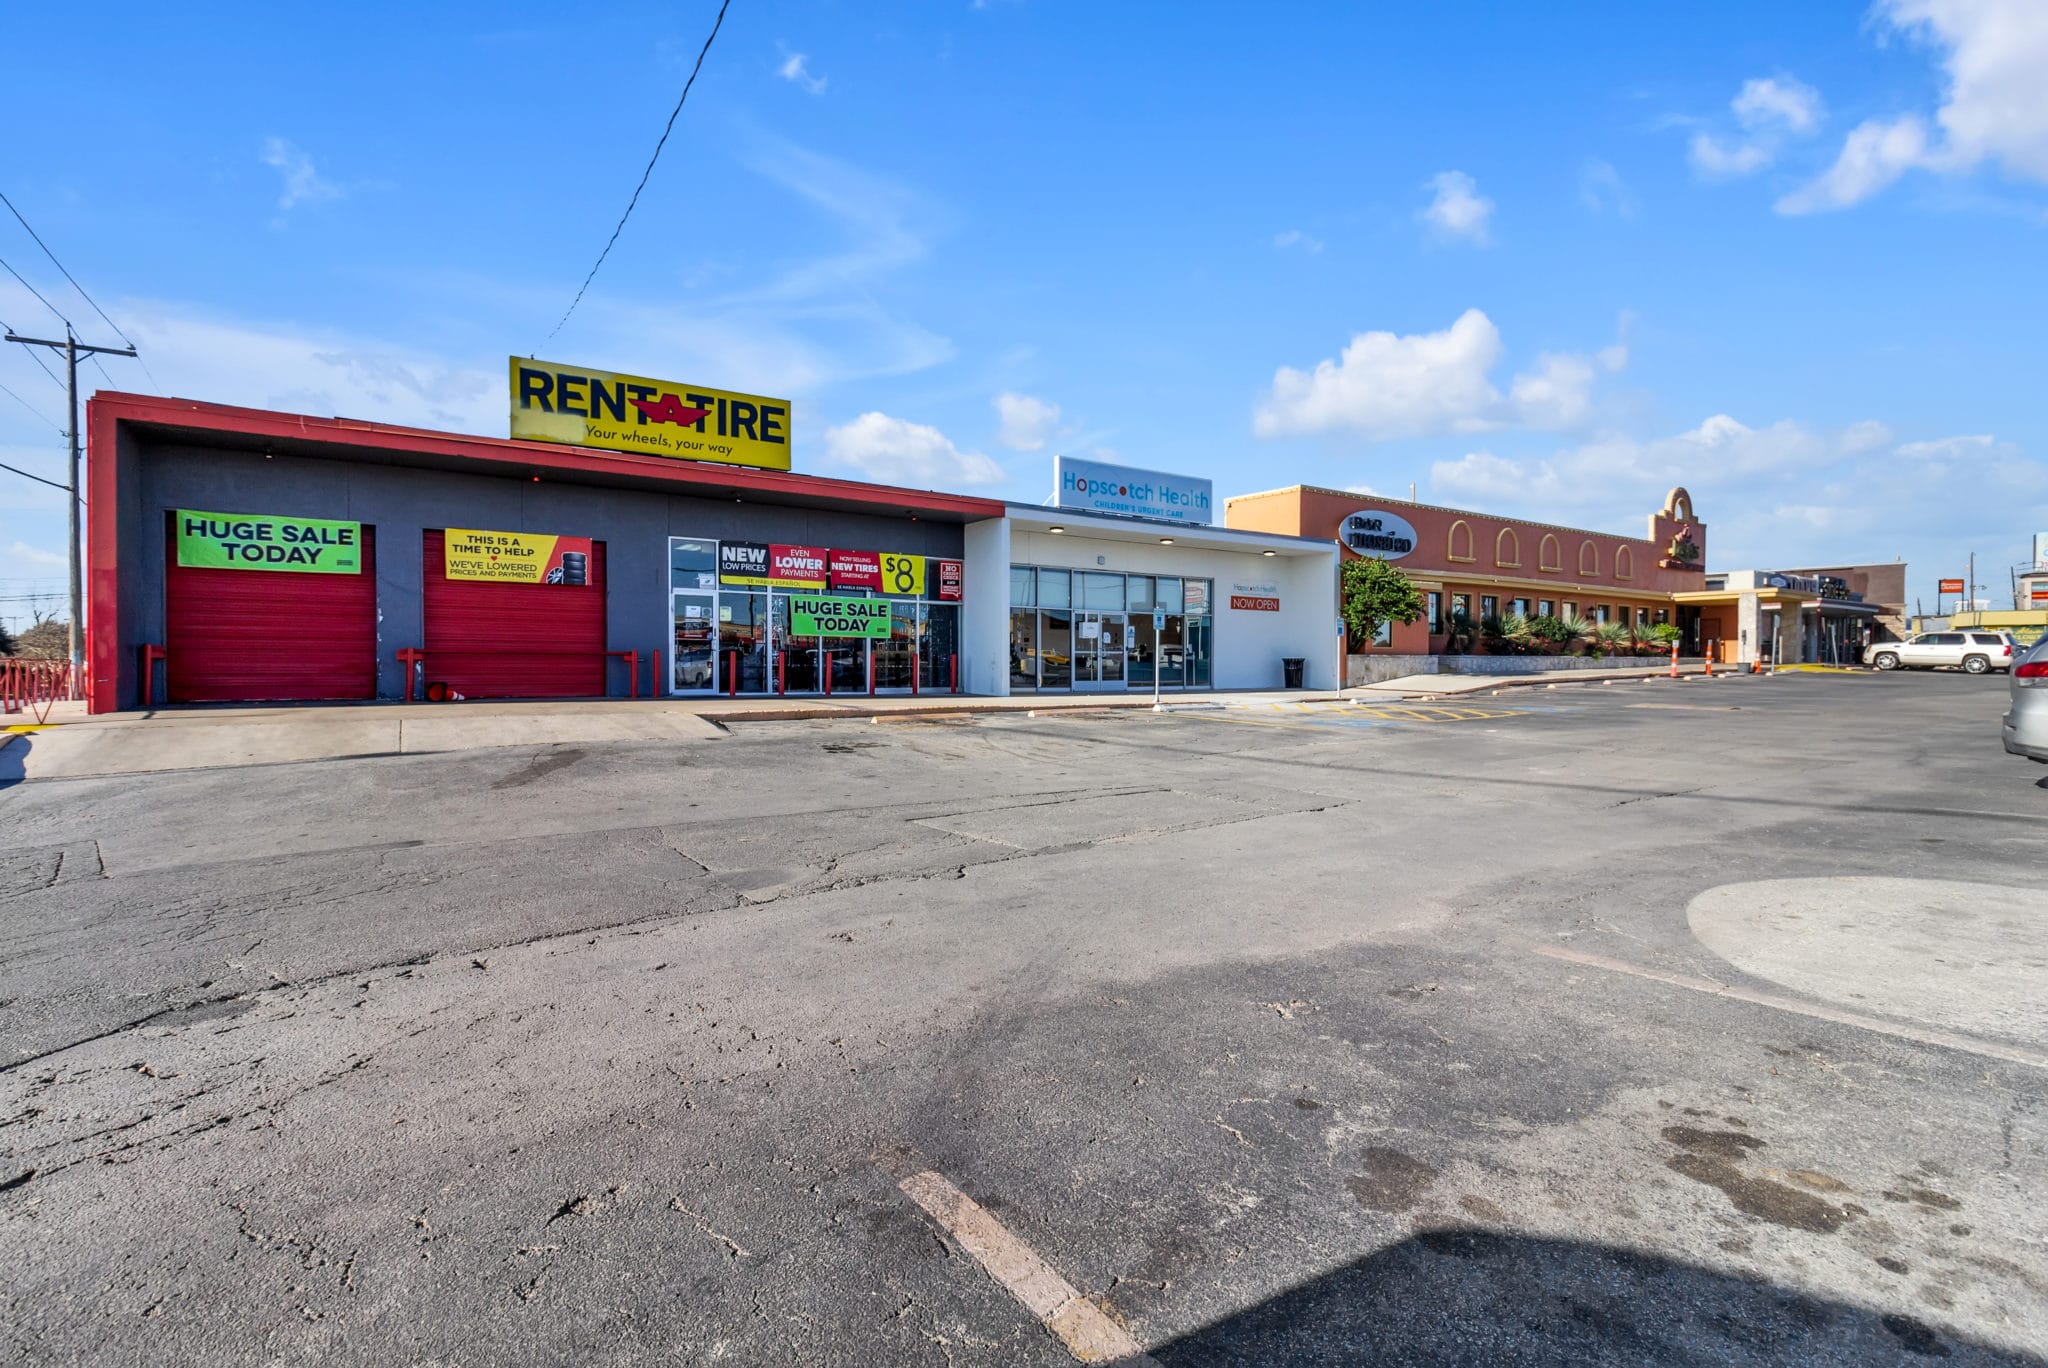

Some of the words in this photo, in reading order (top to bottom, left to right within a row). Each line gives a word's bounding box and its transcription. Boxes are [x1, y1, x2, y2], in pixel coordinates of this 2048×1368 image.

[586, 424, 616, 440] Your
[622, 430, 672, 448] wheels,
[675, 441, 704, 452] your
[708, 445, 733, 456] way
[1159, 485, 1209, 509] Health
[1094, 499, 1136, 513] CHILDREN'S
[1138, 505, 1164, 516] URGENT
[1166, 509, 1184, 518] CARE
[185, 518, 273, 541] HUGE
[282, 525, 353, 546] SALE
[467, 535, 494, 545] THIS
[497, 537, 508, 545] IS
[511, 538, 520, 546] A
[221, 542, 323, 564] TODAY
[452, 544, 482, 554] TIME
[485, 546, 501, 555] TO
[504, 547, 534, 557] HELP
[722, 546, 766, 563] NEW
[790, 549, 810, 557] EVEN
[450, 560, 483, 569] WE'VE
[486, 562, 537, 572] LOWERED
[722, 562, 740, 570] LOW
[741, 563, 766, 572] PRICES
[775, 556, 824, 570] LOWER
[831, 562, 855, 571] NEW
[855, 563, 879, 573] TIRES
[450, 568, 477, 576] PRICES
[780, 568, 819, 578] PAYMENTS
[794, 600, 842, 616] HUGE
[847, 603, 887, 617] SALE
[1233, 598, 1255, 608] NOW
[1256, 599, 1278, 610] OPEN
[814, 617, 870, 632] TODAY
